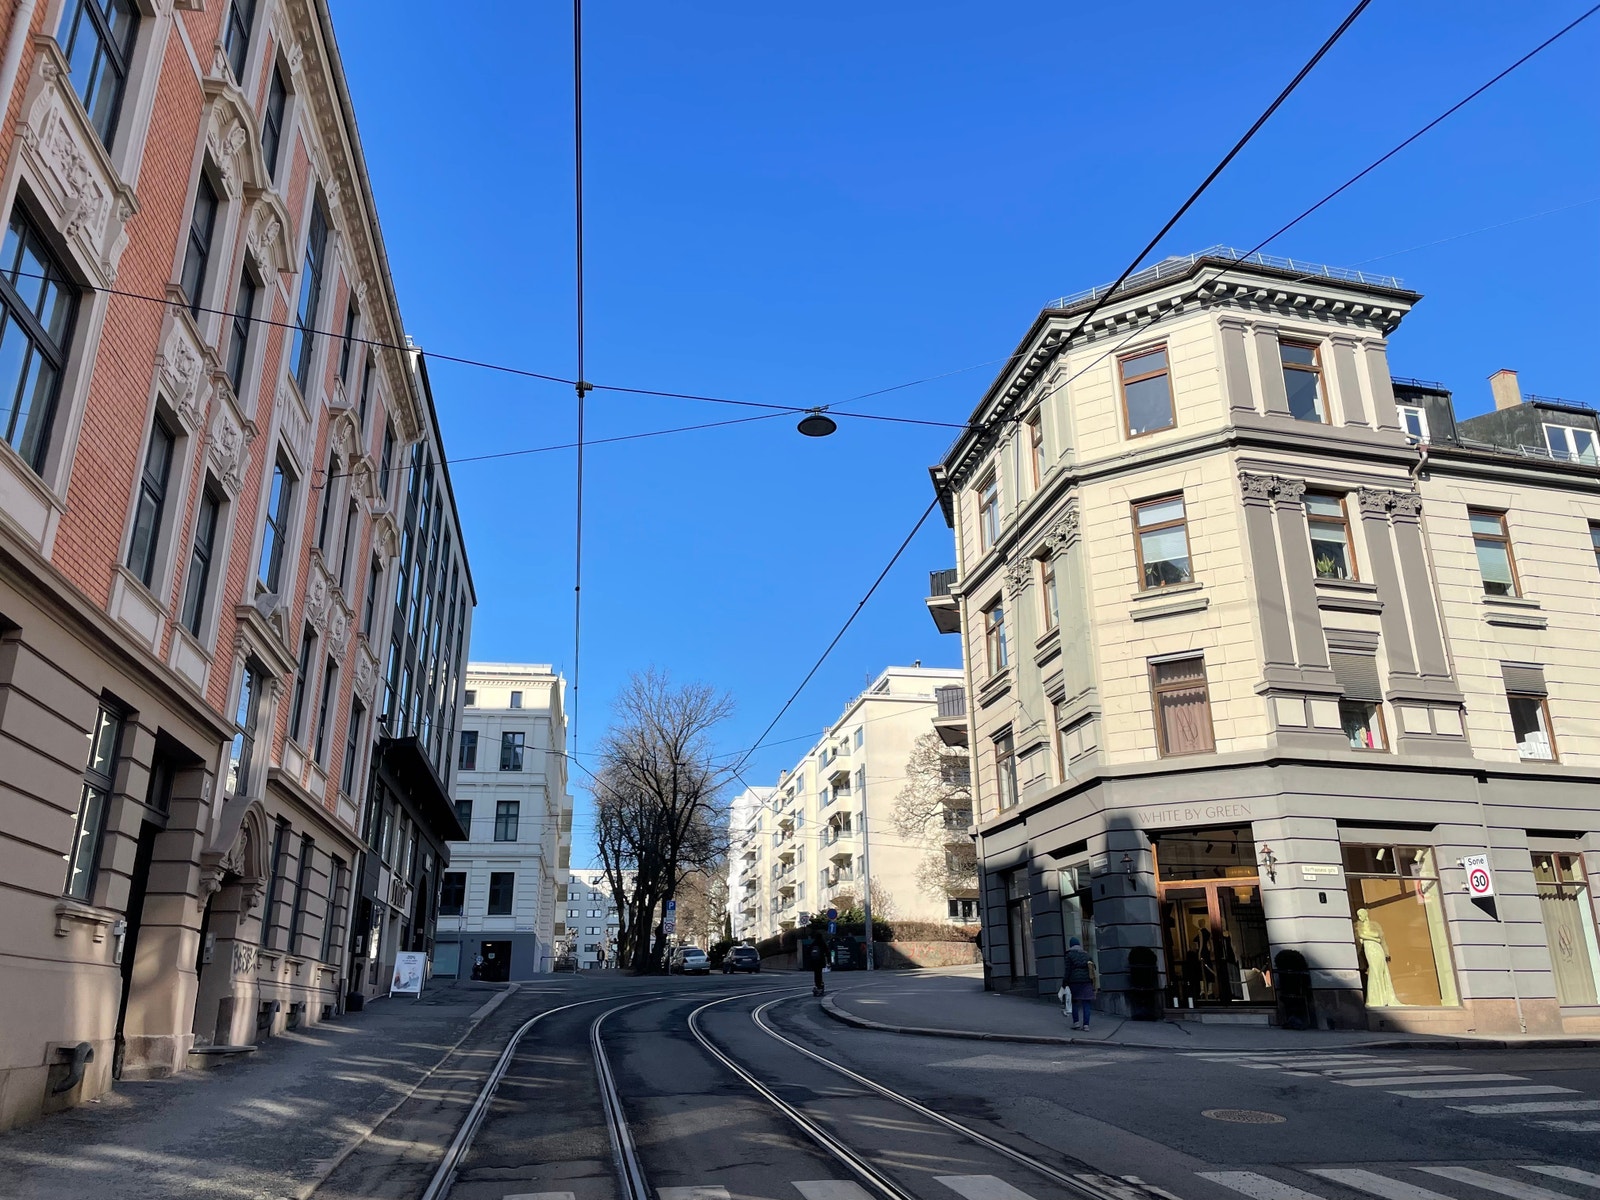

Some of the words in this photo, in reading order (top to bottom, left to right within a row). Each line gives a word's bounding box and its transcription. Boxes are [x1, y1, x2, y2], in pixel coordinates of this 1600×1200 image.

[1138, 809, 1180, 823] WHITE
[1185, 808, 1201, 820] BY
[1205, 804, 1251, 818] GREEN
[1468, 857, 1484, 866] Sone
[1473, 875, 1486, 887] 30
